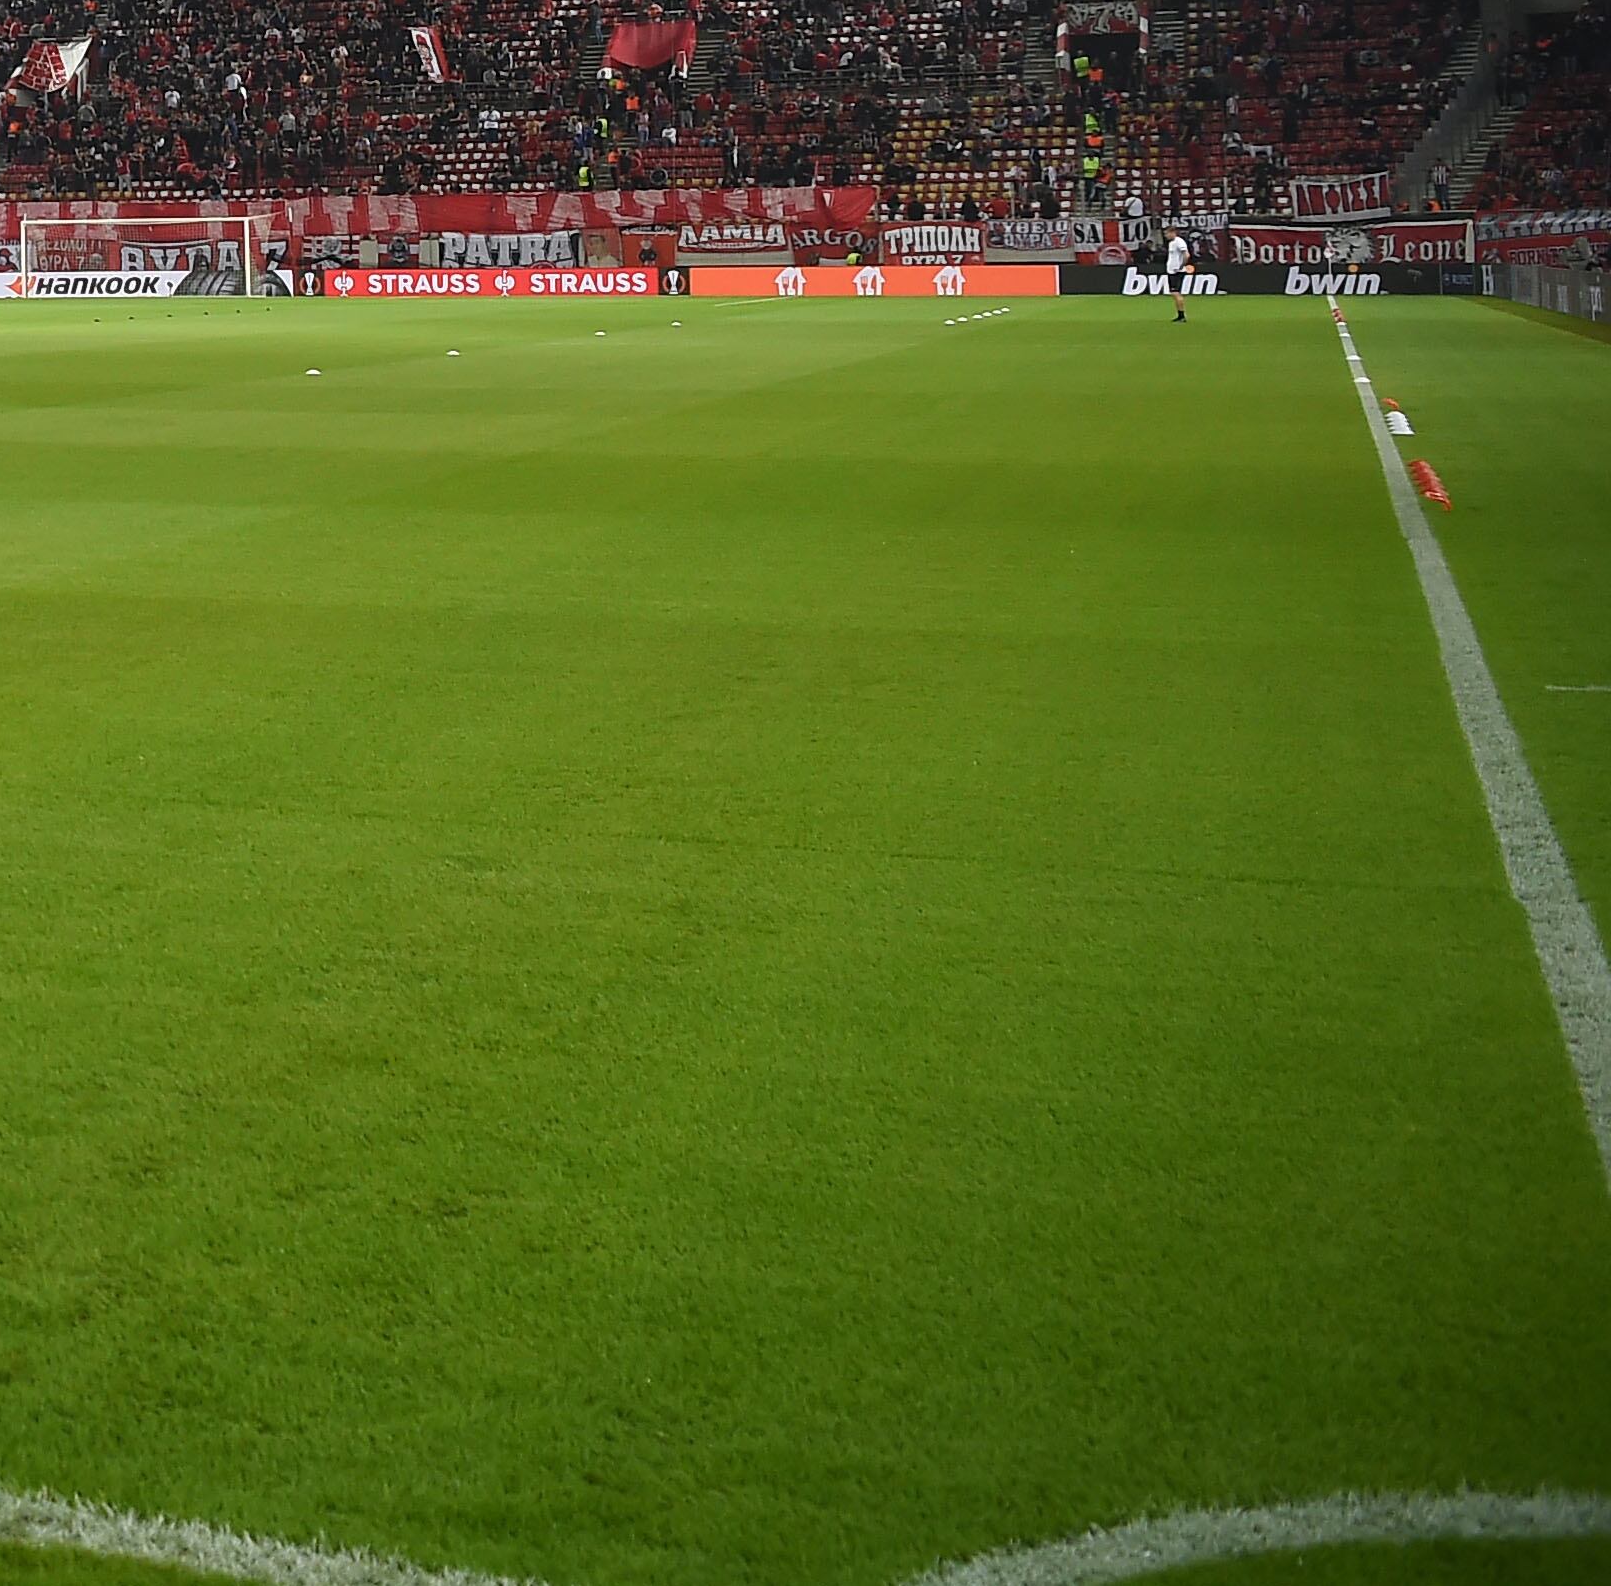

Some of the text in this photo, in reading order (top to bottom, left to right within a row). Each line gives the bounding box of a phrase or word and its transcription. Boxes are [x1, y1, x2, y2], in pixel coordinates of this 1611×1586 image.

[885, 225, 981, 254] ΤΡΙΠΟΛΗ
[368, 273, 481, 294] STRAUSS
[530, 273, 647, 294] STRAUSS
[1284, 264, 1381, 295] bwin
